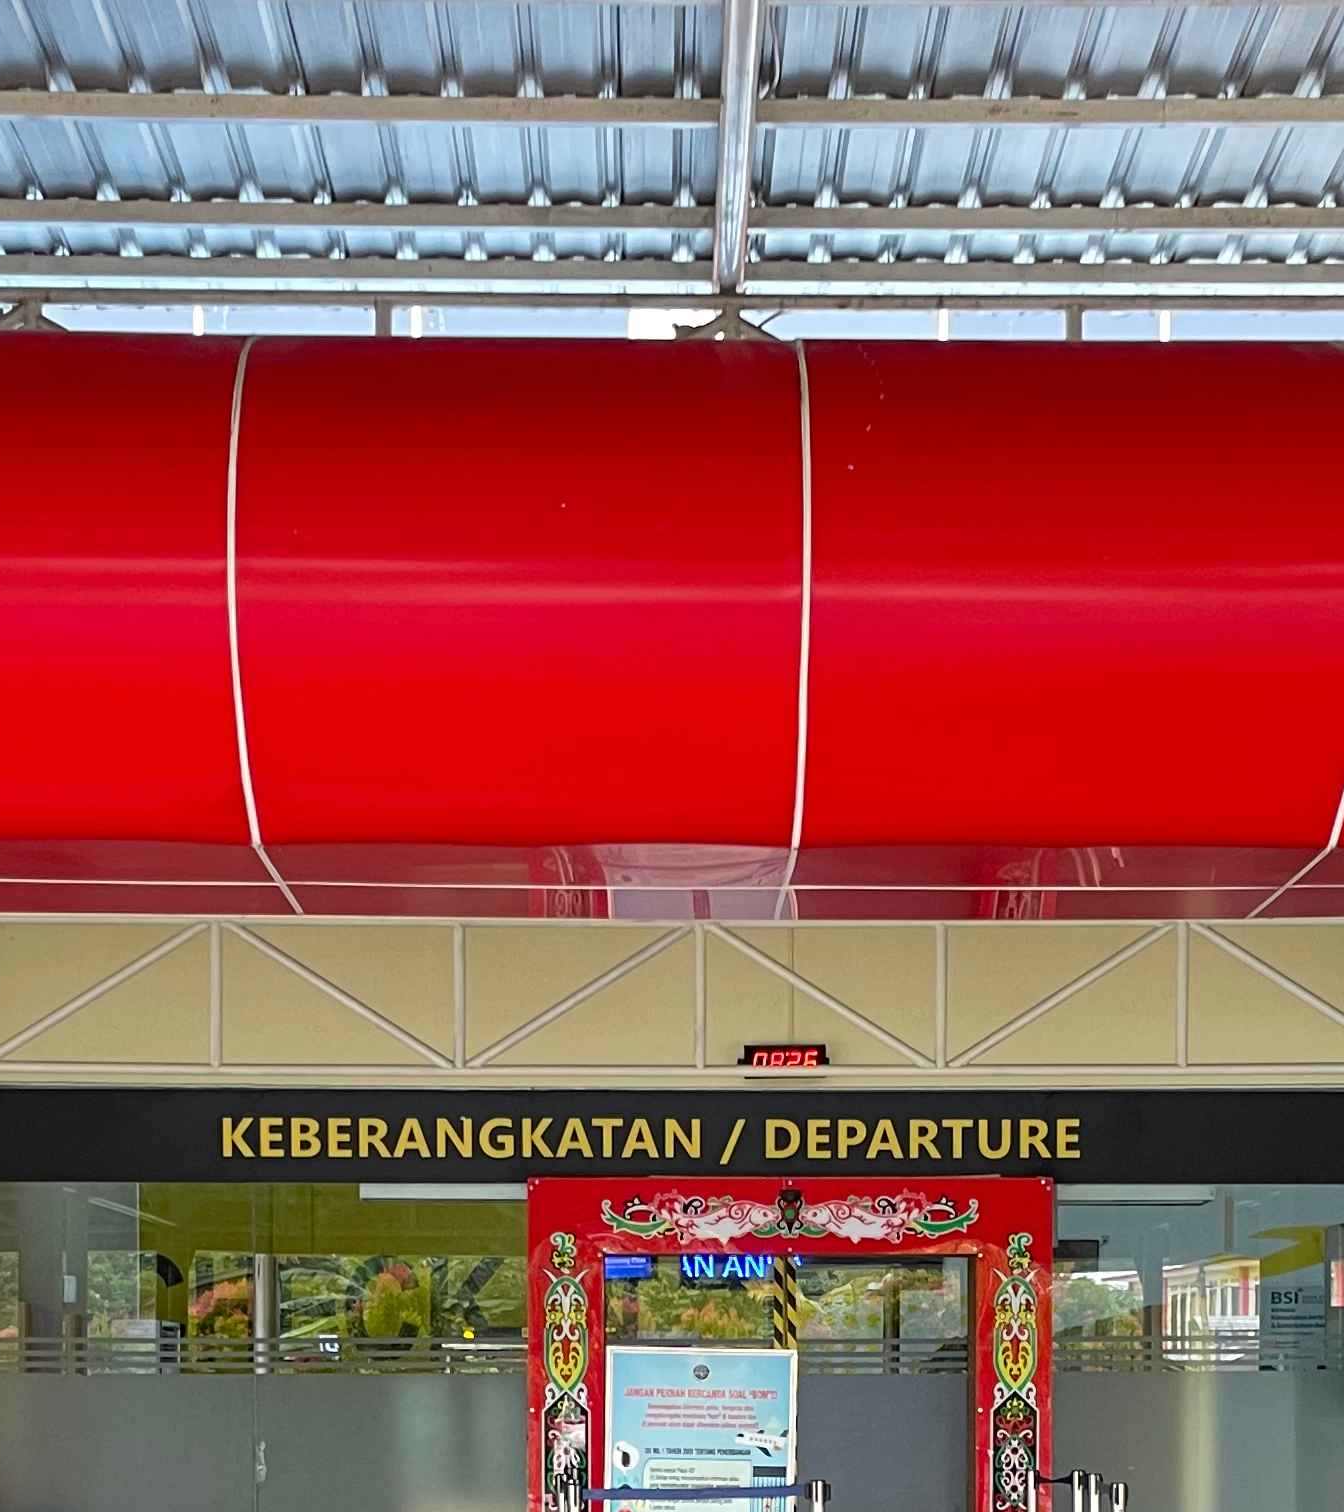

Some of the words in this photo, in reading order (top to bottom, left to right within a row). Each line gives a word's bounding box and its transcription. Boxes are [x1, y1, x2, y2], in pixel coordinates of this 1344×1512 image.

[222, 1116, 701, 1159] KEBERANGKATAN
[719, 1118, 746, 1165] /
[764, 1118, 1081, 1160] DEPARTURE
[1271, 1287, 1300, 1305] BSI
